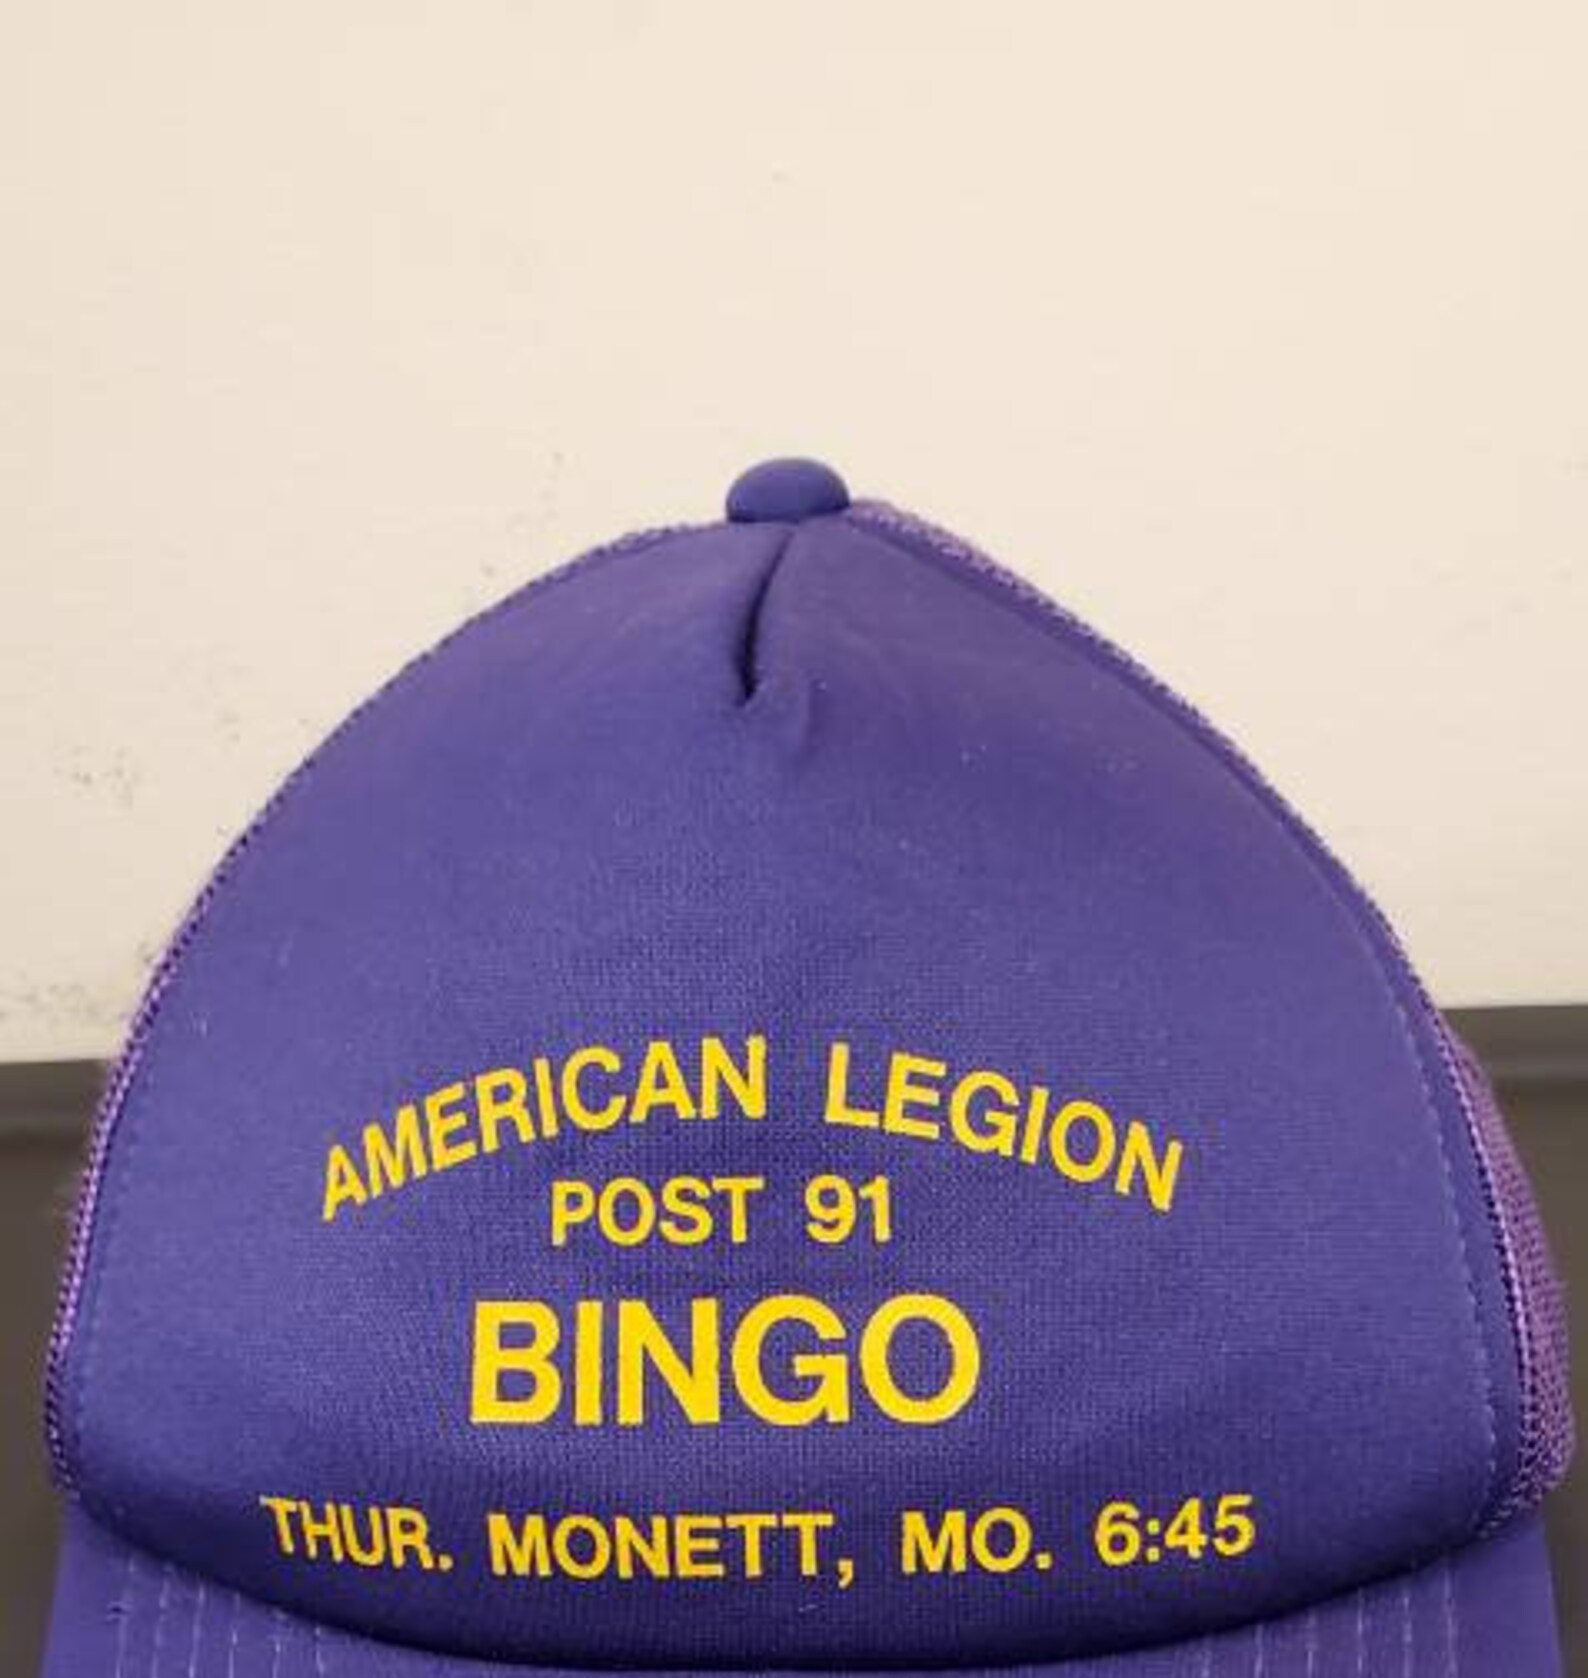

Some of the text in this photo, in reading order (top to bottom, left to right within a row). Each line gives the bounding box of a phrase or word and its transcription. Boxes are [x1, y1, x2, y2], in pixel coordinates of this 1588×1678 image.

[321, 1034, 1184, 1222] AMERICAN LEGION
[550, 1174, 892, 1247] POST 91
[469, 1291, 982, 1428] BINGO
[260, 1493, 1256, 1588] THUR. MONETT, MO. 6:45
